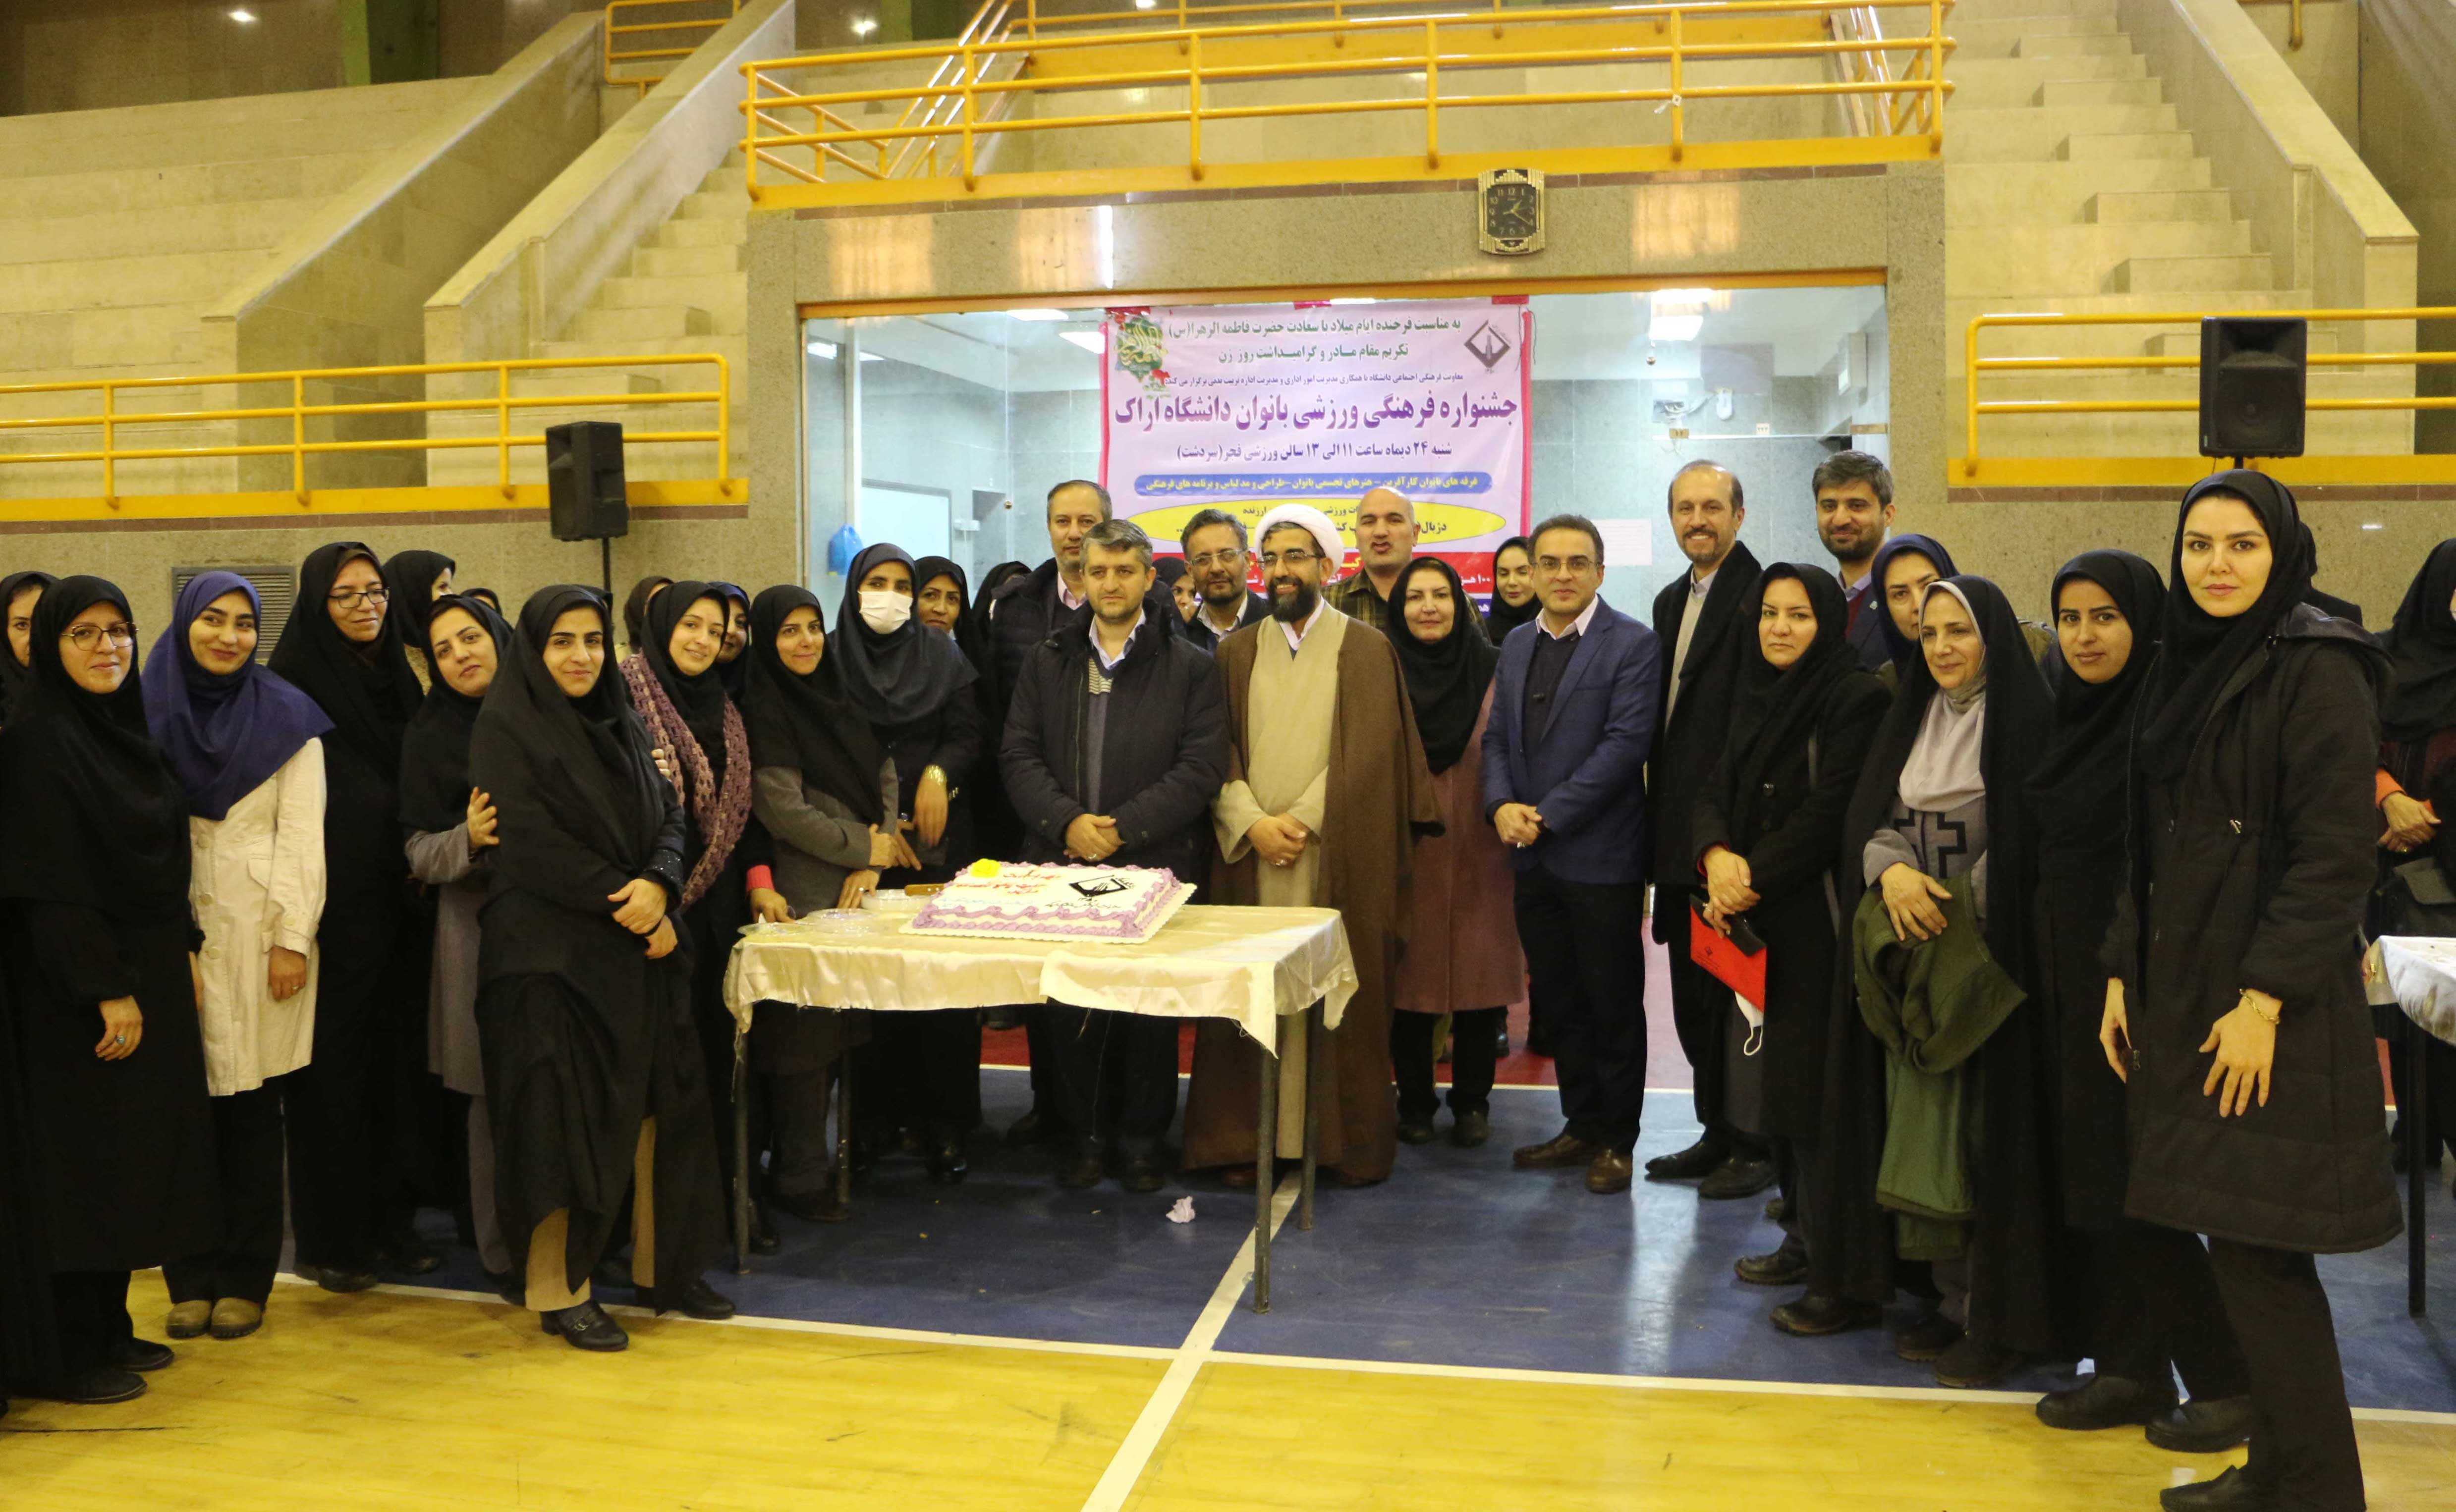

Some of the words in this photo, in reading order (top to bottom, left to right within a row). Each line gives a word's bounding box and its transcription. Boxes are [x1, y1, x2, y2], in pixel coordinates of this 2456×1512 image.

[1222, 320, 1250, 333] فاطمه
[1252, 321, 1284, 337] حضرت
[1287, 320, 1318, 333] سعادت
[1321, 320, 1328, 335] با
[1331, 319, 1353, 335] میلاد
[1356, 319, 1373, 335] ایام
[1376, 316, 1412, 335] فرخنده
[1414, 316, 1449, 333] مناسبت
[1451, 319, 1460, 333] به
[1218, 348, 1232, 364] زن
[1238, 348, 1254, 363] روز
[1320, 348, 1325, 362] و
[1328, 344, 1356, 362] مادر
[1359, 343, 1379, 361] مقام
[1382, 343, 1408, 361] تکریم
[1179, 378, 1188, 387] می
[1189, 377, 1207, 387] برگزار
[1240, 376, 1255, 386] اداره
[1256, 376, 1279, 385] مدیریت
[1284, 375, 1301, 386] اداری
[1303, 375, 1315, 385] امور
[1316, 375, 1338, 385] مدیریت
[1339, 374, 1362, 385] همکاری
[1369, 373, 1391, 381] دانشگاه
[1392, 373, 1418, 383] اجتماعی
[1418, 373, 1441, 383] فرهنگی
[1443, 372, 1463, 382] معاونت
[1115, 395, 1160, 432] اراک
[1164, 395, 1231, 423] دانشگاه
[1235, 394, 1288, 431] بانوان
[1293, 395, 1358, 431] ورزشی
[1363, 389, 1436, 429] فرهنگی
[1440, 390, 1518, 429] جشنواره
[1243, 445, 1278, 462] ورزشی
[1280, 444, 1304, 461] سالن
[1306, 443, 1319, 458] ۱۳
[1322, 442, 1340, 460] الی
[1342, 442, 1352, 457] ۱۱
[1355, 442, 1383, 456] ساعت
[1385, 442, 1411, 459] دیماه
[1413, 440, 1429, 457] ۲۴
[1431, 442, 1452, 459] شنبه
[1146, 480, 1174, 490] فرهنگی
[1175, 480, 1190, 490] های
[1192, 481, 1214, 490] برنامه
[1220, 479, 1238, 489] لباس
[1291, 478, 1314, 489] بانوان
[1315, 478, 1343, 489] تجسمی
[1419, 477, 1441, 488] بانوان
[1443, 477, 1458, 488] های
[1460, 476, 1478, 488] غرفه
